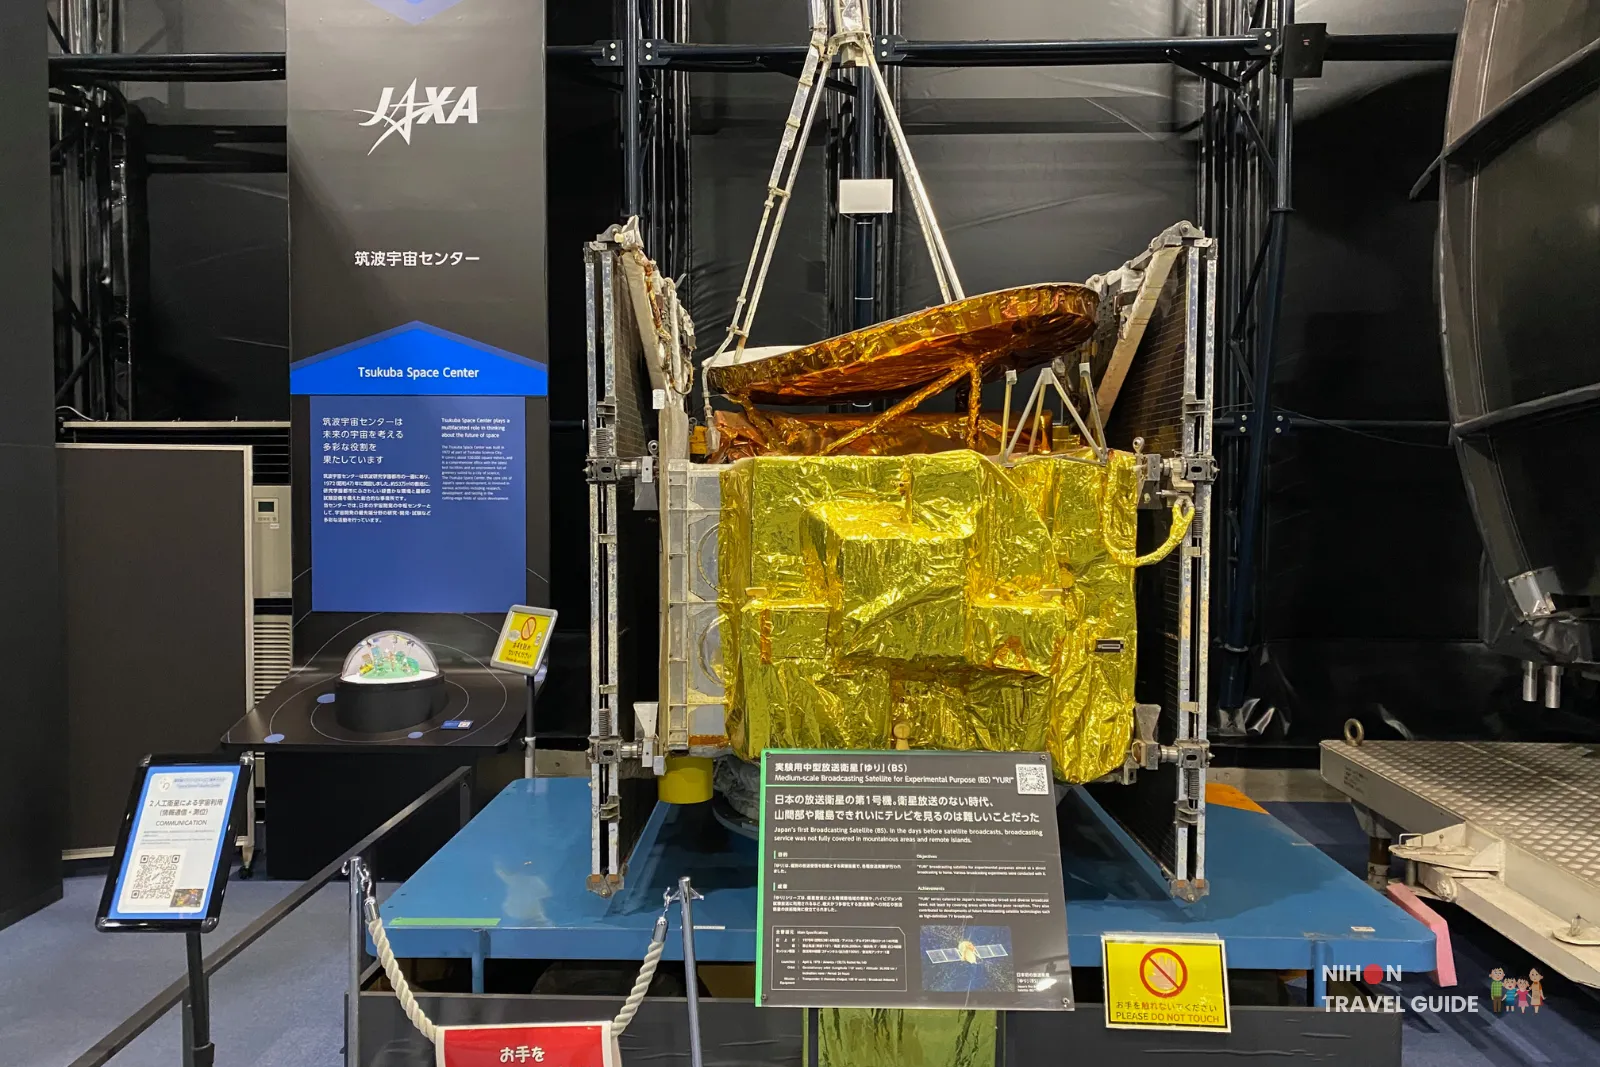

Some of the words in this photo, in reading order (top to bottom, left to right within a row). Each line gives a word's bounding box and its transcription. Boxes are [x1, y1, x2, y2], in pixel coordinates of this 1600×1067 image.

[353, 78, 478, 156] JAXA
[354, 251, 480, 266] 筑波宇宙センター
[357, 366, 403, 377] Tsukuba
[407, 366, 439, 380] Space
[443, 366, 480, 377] Center
[323, 418, 402, 426] 筑波宇宙センターは
[323, 430, 403, 439] 未来の宇宙を考える
[323, 443, 376, 451] 多彩な役割を
[323, 456, 383, 464] 果たしています
[821, 775, 864, 783] Broadcasting
[950, 776, 976, 784] Purpose
[978, 776, 991, 784] (BS)
[775, 795, 994, 806] 日本の放送衛星の第1号機。衛星放送のない時代、
[1116, 1012, 1148, 1020] PLEASE
[1189, 1015, 1219, 1023] TOUCH
[500, 1046, 544, 1063] お手を
